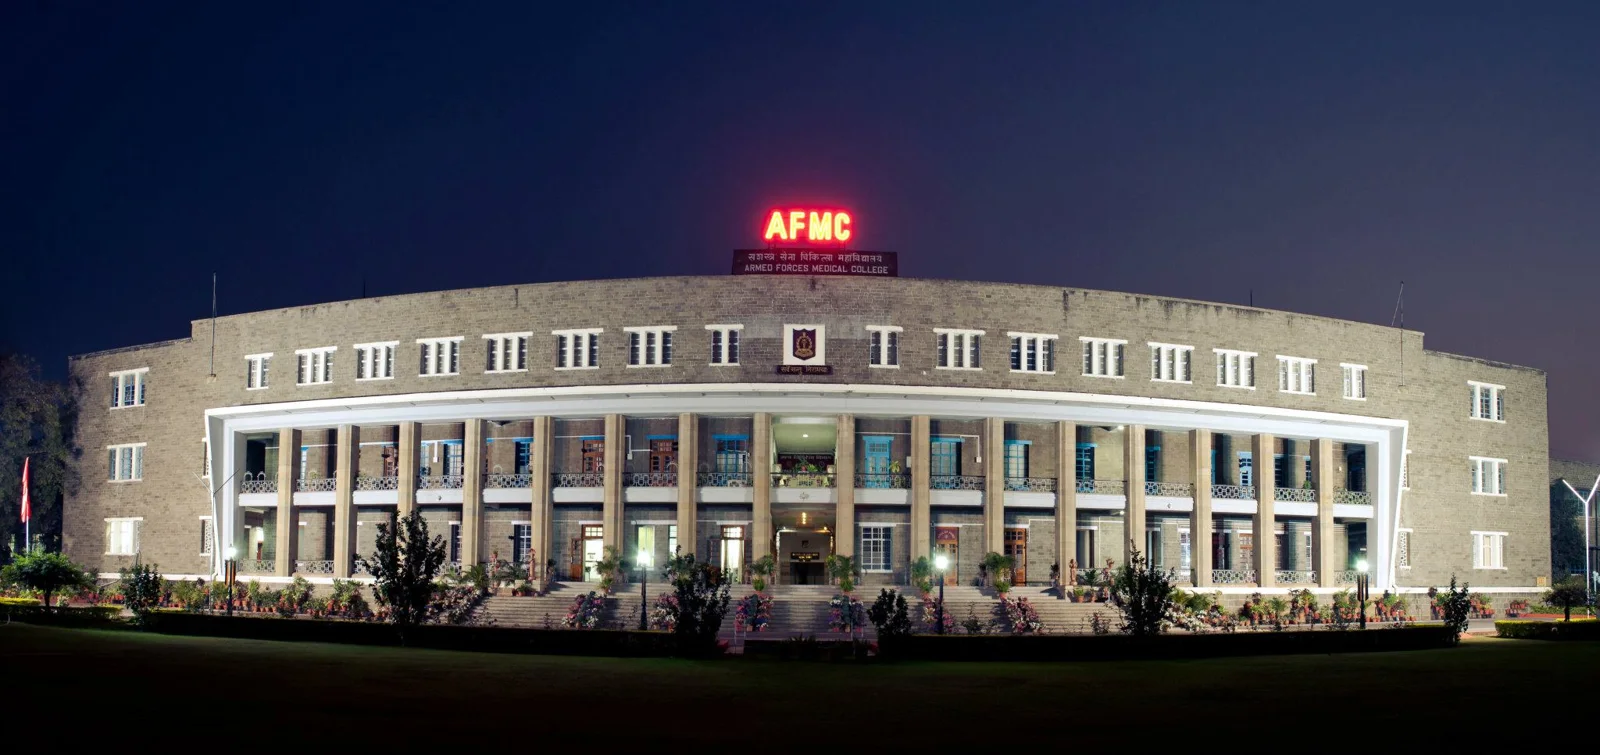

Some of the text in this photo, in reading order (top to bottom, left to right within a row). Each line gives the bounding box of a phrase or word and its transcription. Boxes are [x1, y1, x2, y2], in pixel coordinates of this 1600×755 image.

[765, 211, 851, 241] AFMC
[748, 251, 882, 263] सशस्त्र सेना चिकित्सा महाविद्यालय
[744, 264, 889, 274] ARMED FORCES MEDICAL COLLEGE
